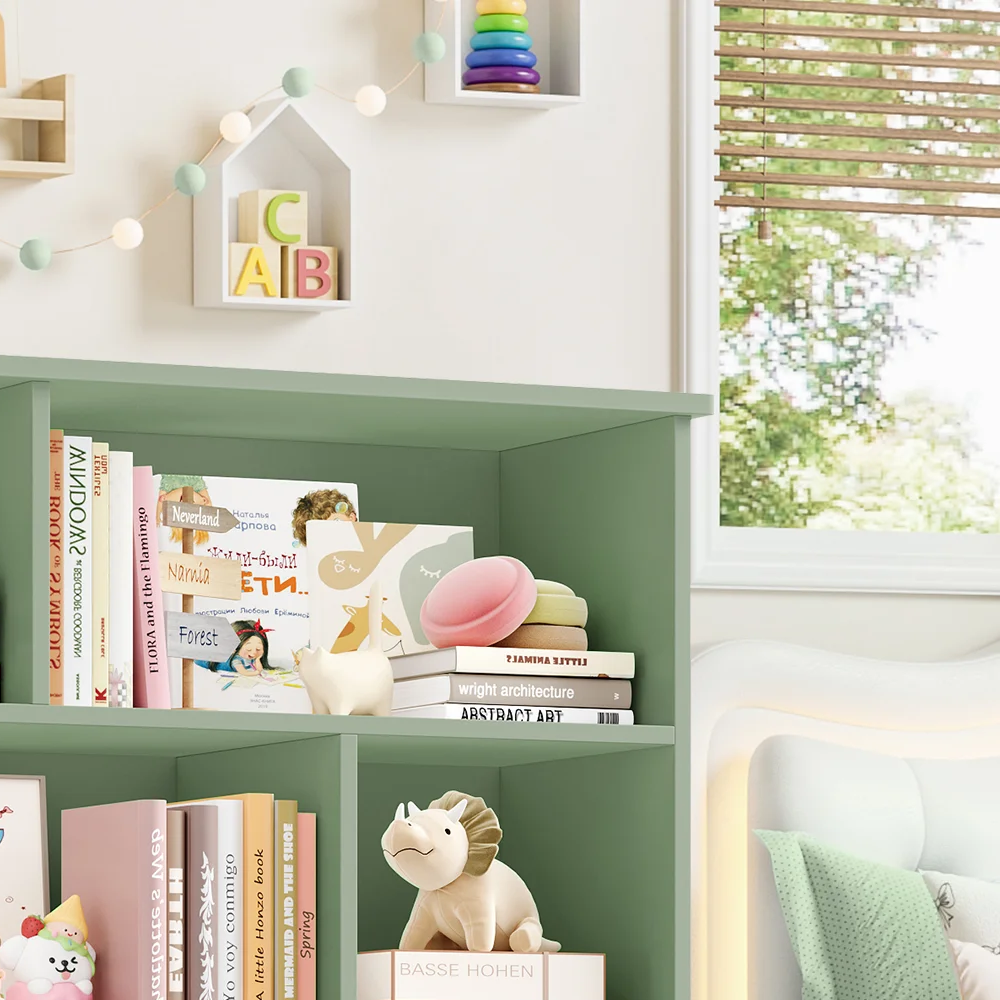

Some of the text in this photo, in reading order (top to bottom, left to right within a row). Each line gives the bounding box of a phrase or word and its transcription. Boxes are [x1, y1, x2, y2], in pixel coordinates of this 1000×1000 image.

[266, 193, 301, 244] C
[234, 247, 332, 298] A B
[171, 505, 220, 527] Neverland
[233, 510, 270, 519] Наталья
[235, 521, 277, 531] арпова
[138, 506, 159, 674] FLORA and the Flamingo
[179, 626, 219, 647] Forest
[459, 682, 574, 699] wright architecture
[283, 823, 294, 862] SHOE
[254, 849, 264, 885] book
[283, 864, 294, 894] THE
[224, 853, 237, 933] conmigo
[255, 891, 265, 940] Honzo
[283, 896, 294, 927] AND
[298, 911, 315, 959] Spring
[226, 941, 238, 973] voy
[254, 947, 264, 983] little
[284, 929, 294, 999] MERMAID
[400, 962, 534, 978] BASSE HOHEN
